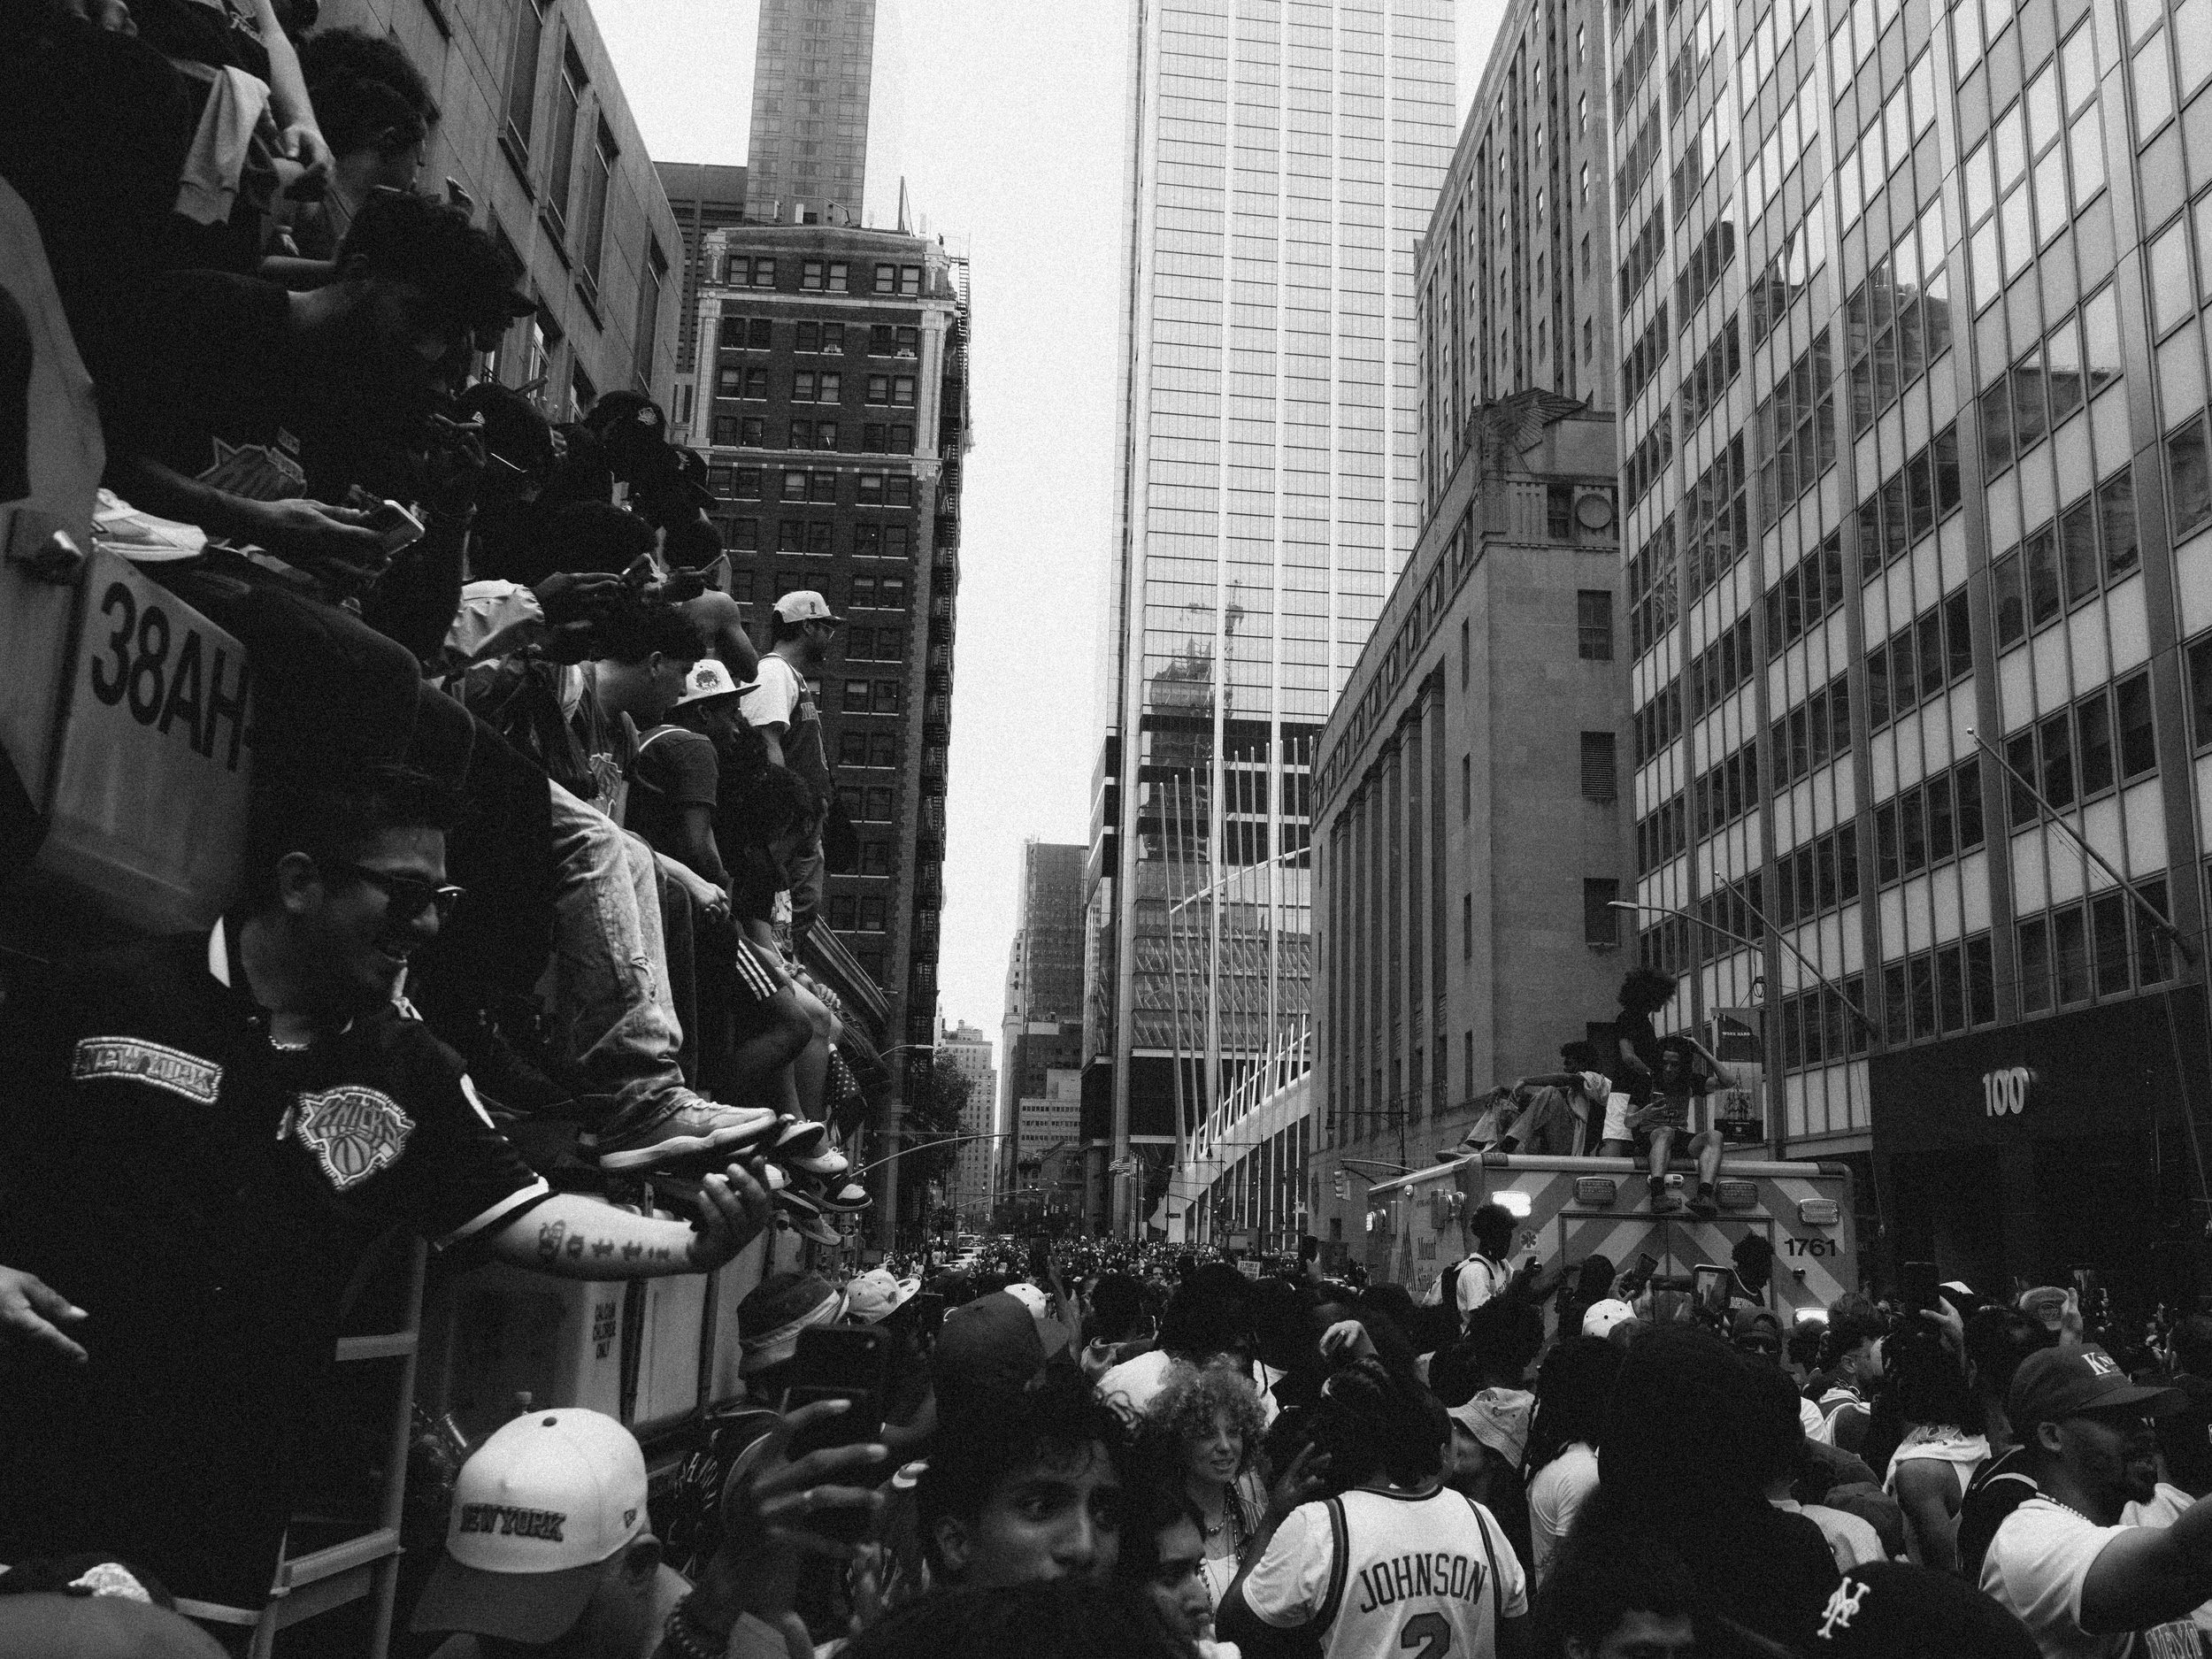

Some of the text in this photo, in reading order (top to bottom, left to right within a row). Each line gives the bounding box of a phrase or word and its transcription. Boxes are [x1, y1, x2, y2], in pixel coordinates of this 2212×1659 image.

[141, 1049, 215, 1097] YORK
[1982, 1066, 2028, 1117] 100
[306, 1099, 399, 1153] KNICKS
[1417, 1236, 1436, 1260] Mount
[1784, 1238, 1836, 1256] 1761
[499, 1505, 567, 1542] YORK
[1359, 1553, 1488, 1614] JOHNSON
